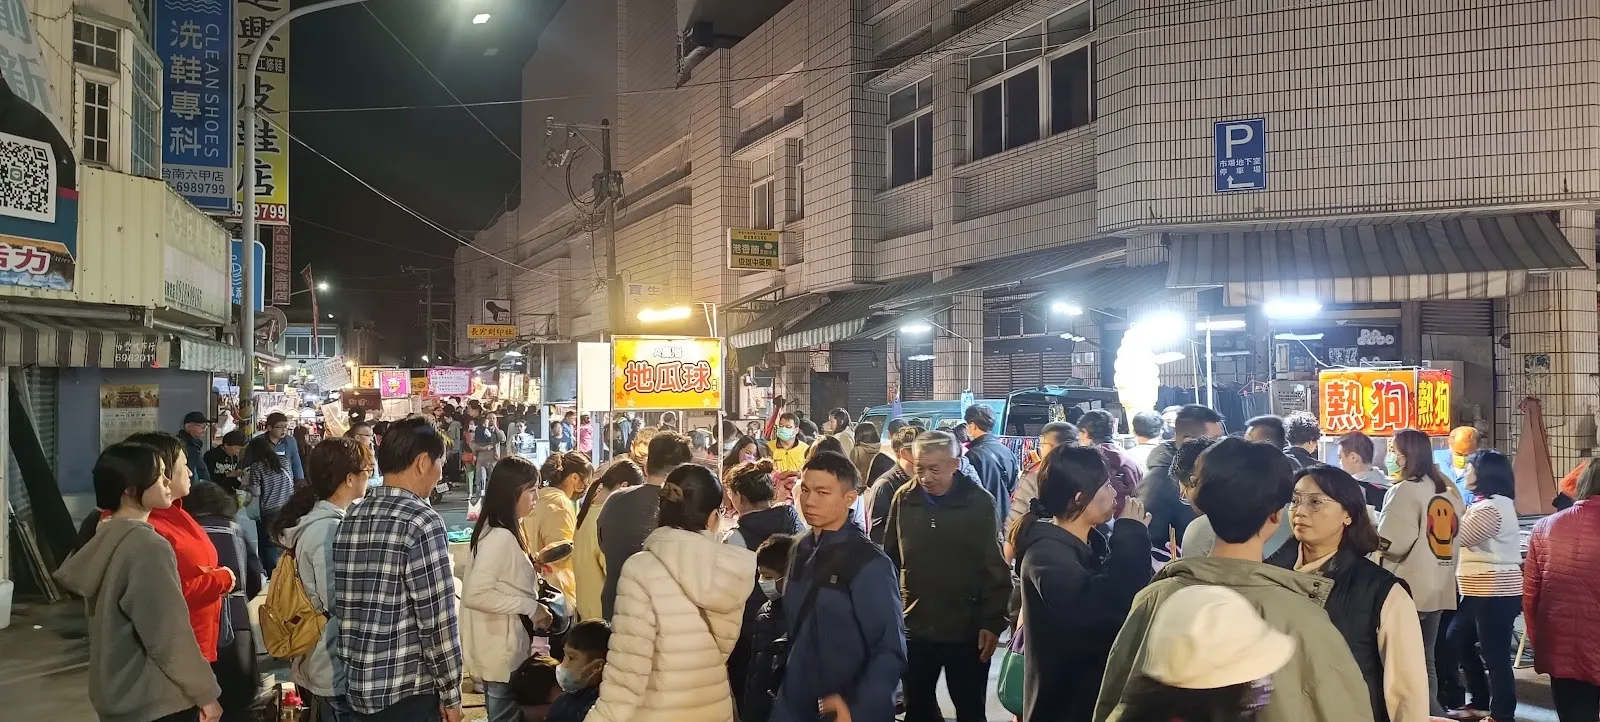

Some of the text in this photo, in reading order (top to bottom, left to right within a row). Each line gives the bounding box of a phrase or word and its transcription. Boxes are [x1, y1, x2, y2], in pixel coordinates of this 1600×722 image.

[170, 20, 202, 156] 洗鞋專科
[1226, 124, 1253, 158] P
[162, 168, 223, 182] 台南六甲店
[1219, 157, 1261, 168] 市場地下室
[1219, 165, 1261, 176] 停車場
[172, 181, 224, 194] -6989799
[624, 361, 711, 393] 地瓜球
[1325, 379, 1409, 430] 熱狗
[1418, 380, 1449, 428] 熱狗
